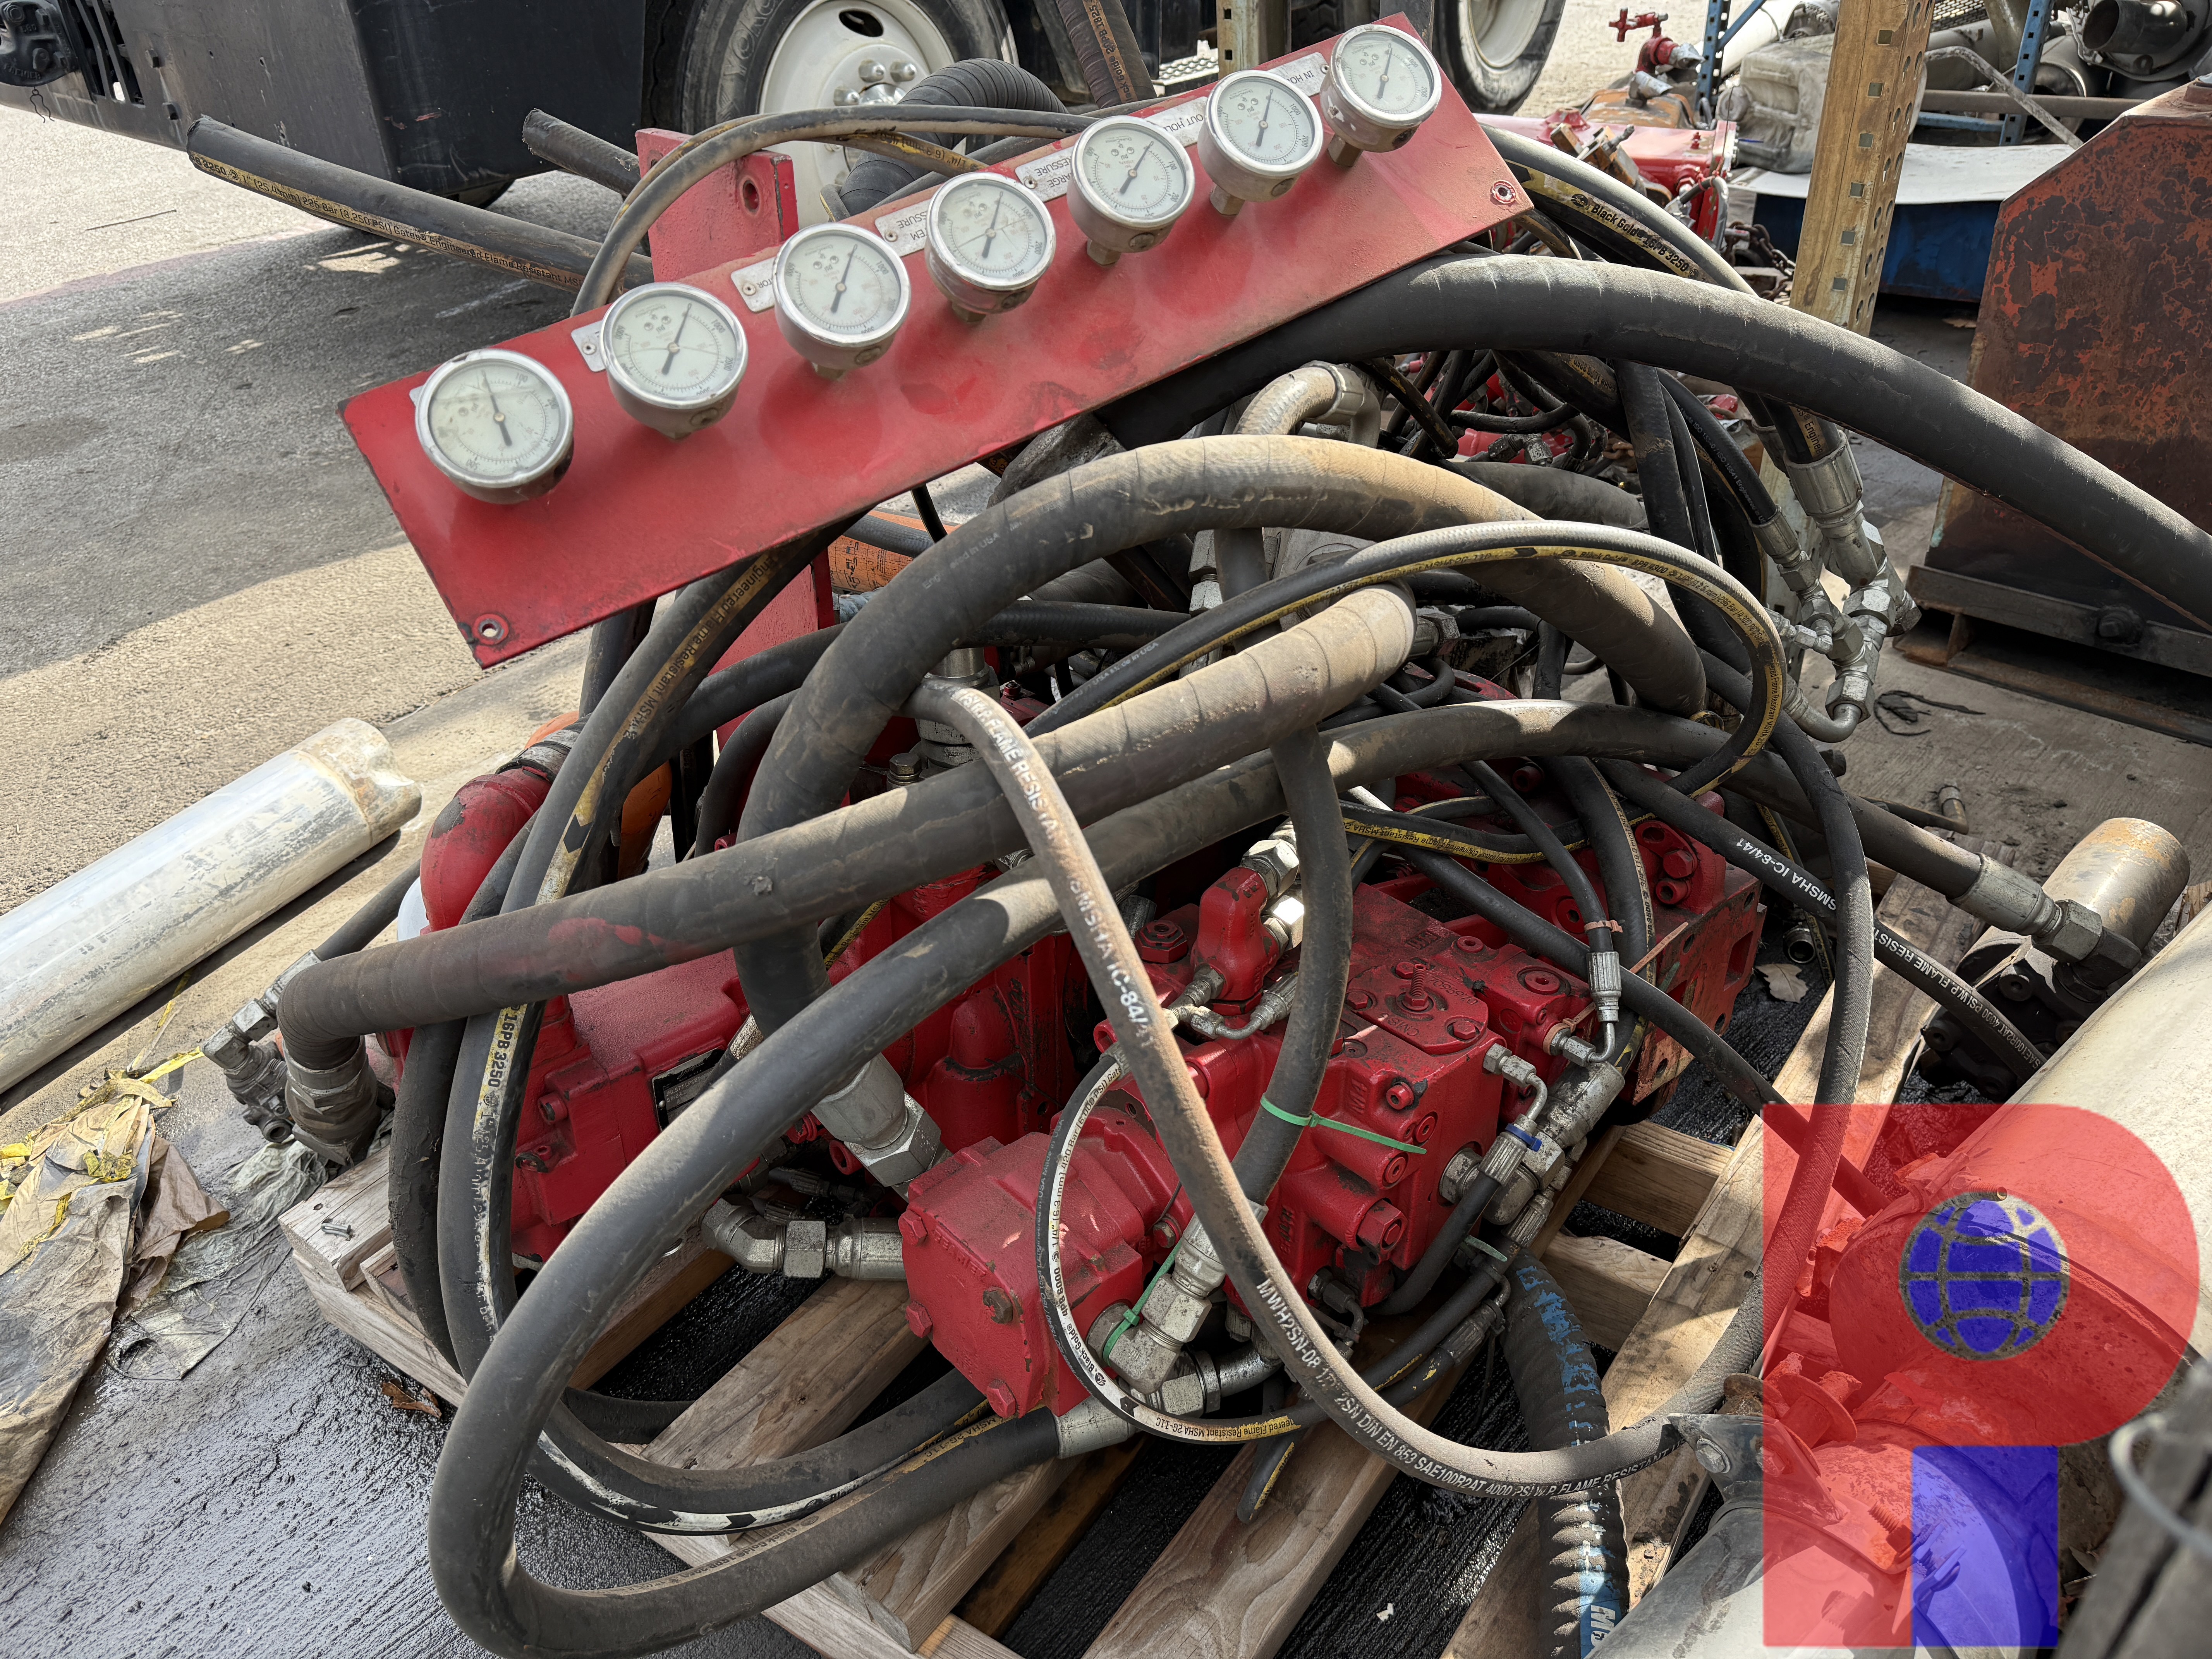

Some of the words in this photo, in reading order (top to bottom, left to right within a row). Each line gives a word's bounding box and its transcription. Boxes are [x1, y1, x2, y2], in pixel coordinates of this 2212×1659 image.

[1089, 4, 1104, 28] 1825
[1407, 57, 1419, 68] 1000
[1304, 70, 1315, 80] IN
[1290, 103, 1301, 115] 1000
[1187, 114, 1204, 126] OUT
[1168, 161, 1177, 170] 100
[1170, 192, 1180, 203] 200
[203, 160, 227, 176] 3250
[323, 203, 337, 215] Bar
[516, 259, 562, 282] Resistant
[1022, 207, 1033, 220] 1000
[1591, 203, 1617, 225] Black
[1664, 250, 1689, 272] 3250
[1034, 241, 1042, 255] 2000
[877, 261, 889, 274] 1000
[711, 319, 726, 333] 1000
[723, 356, 734, 371] 2000
[1716, 451, 1726, 462] ISO
[723, 556, 778, 612] Engineered
[1631, 559, 1649, 568] 8PB
[1719, 595, 1732, 608] 296
[694, 609, 727, 644] Flame
[1139, 641, 1159, 658] USA
[653, 645, 697, 697] Resistant
[1771, 677, 1780, 694] Flame
[1768, 694, 1780, 720] Resistant
[1761, 719, 1775, 737] MSHA
[984, 719, 1023, 762] FLAME
[1353, 824, 1380, 836] MSHA
[1381, 828, 1419, 843] Resistant
[1443, 840, 1479, 857] Engineered
[1736, 838, 1790, 877] IC-84/41
[1913, 955, 1951, 988] FLAME
[1966, 992, 1982, 1012] PSI
[1982, 1006, 2003, 1029] 4000
[497, 1013, 518, 1049] 16PB
[488, 1052, 507, 1087] 3250
[1094, 1080, 1108, 1099] PSI)
[1054, 1118, 1064, 1138] USA
[1068, 1129, 1080, 1147] Bar
[1061, 1148, 1072, 1169] 420
[1054, 1266, 1064, 1295] 6000
[1058, 1295, 1068, 1316] 4PB
[1077, 1347, 1095, 1372] Black
[1256, 1278, 1322, 1368] MWH2SN-08
[1356, 1414, 1383, 1438] DIN
[1376, 1429, 1399, 1451] EN
[1393, 1445, 1418, 1464] 853
[1414, 1456, 1487, 1491] SAE100R2AT
[1486, 1480, 1513, 1496] 4000
[1558, 1477, 1602, 1494] FLAME
[963, 1419, 995, 1435] MSHA
[1156, 1417, 1183, 1432] 2G-11C
[1184, 1424, 1205, 1437] MSHA
[1204, 1429, 1242, 1438] Resistant
[1244, 1426, 1267, 1436] Flame
